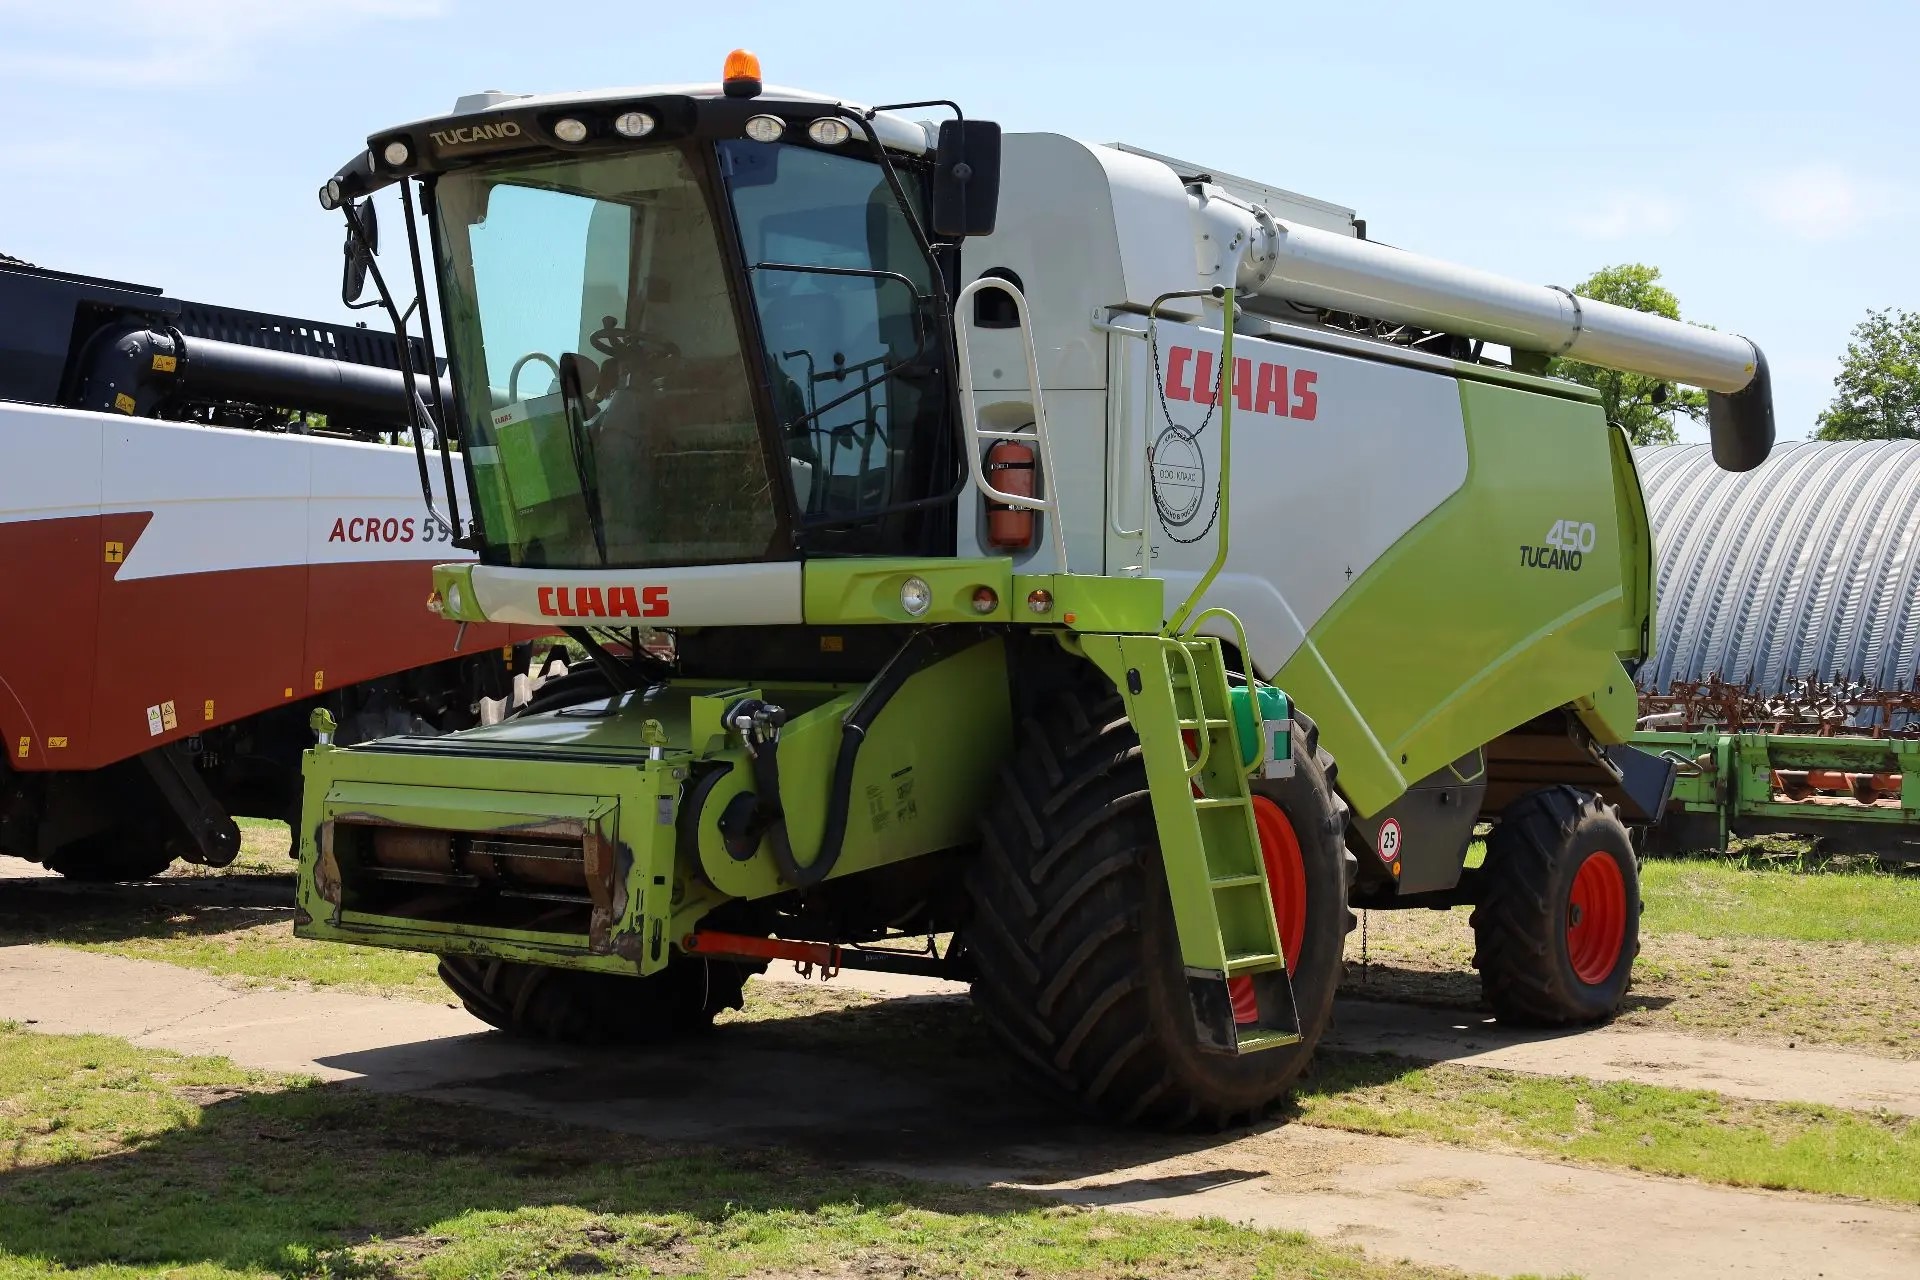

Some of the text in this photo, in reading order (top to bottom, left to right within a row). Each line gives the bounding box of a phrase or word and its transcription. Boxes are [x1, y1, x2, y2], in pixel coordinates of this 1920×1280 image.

[430, 121, 520, 146] TUCANO
[1165, 345, 1318, 421] CLAAS
[494, 413, 512, 425] CLAAS
[328, 517, 415, 543] ACROS
[1546, 519, 1596, 553] 450
[1520, 545, 1582, 571] TUCANO
[538, 586, 670, 617] CLAAS
[1383, 831, 1396, 849] 25
